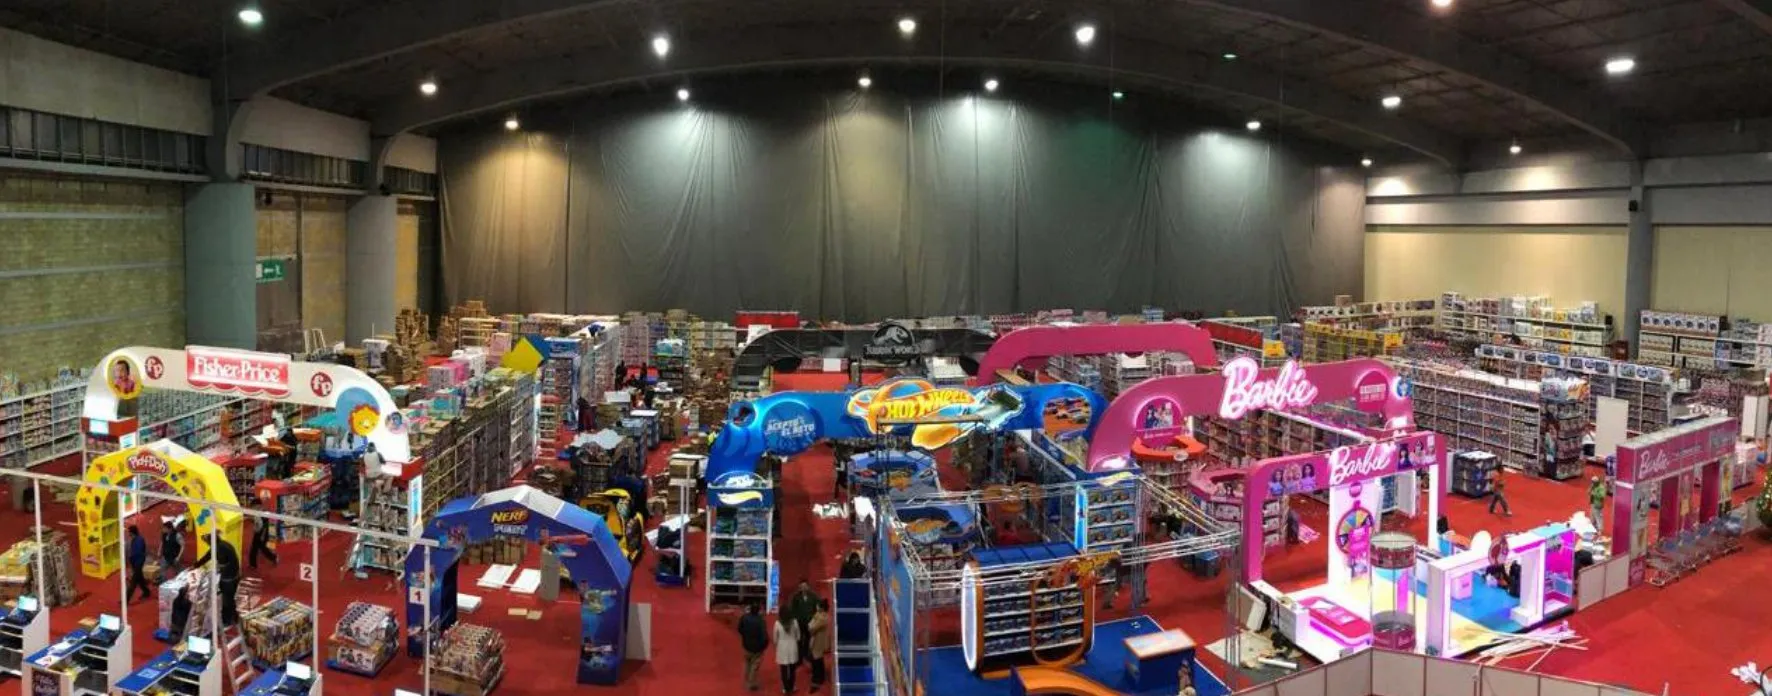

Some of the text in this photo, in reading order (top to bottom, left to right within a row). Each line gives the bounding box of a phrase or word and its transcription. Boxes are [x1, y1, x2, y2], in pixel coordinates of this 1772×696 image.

[194, 356, 280, 383] Fisher-Price
[1220, 357, 1318, 419] Barbie
[1329, 442, 1391, 484] Barbie
[303, 566, 312, 580] 2
[414, 590, 421, 602] 1
